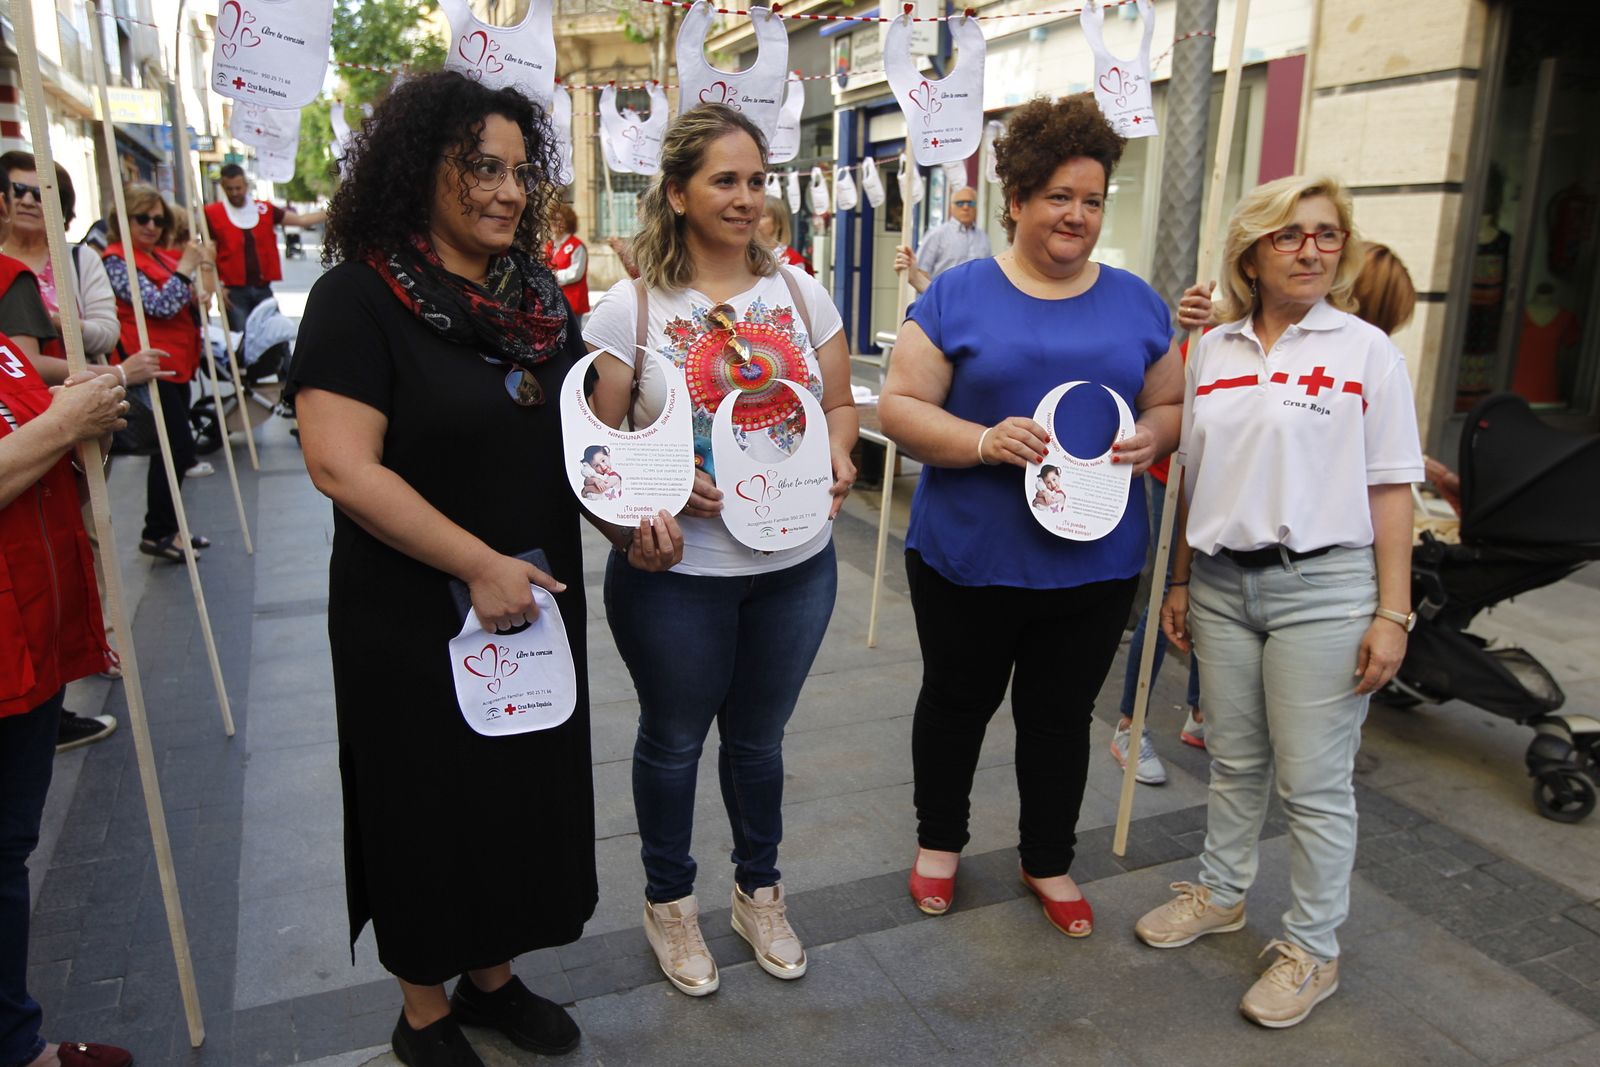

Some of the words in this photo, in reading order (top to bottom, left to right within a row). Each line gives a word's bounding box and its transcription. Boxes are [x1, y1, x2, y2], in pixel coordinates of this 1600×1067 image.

[1283, 400, 1307, 408] Cruz
[1309, 403, 1331, 415] Roja
[608, 430, 641, 440] NINGUNA
[661, 414, 670, 425] SIN
[777, 478, 793, 489] Abre
[795, 478, 803, 487] tu
[633, 505, 653, 513] puedes
